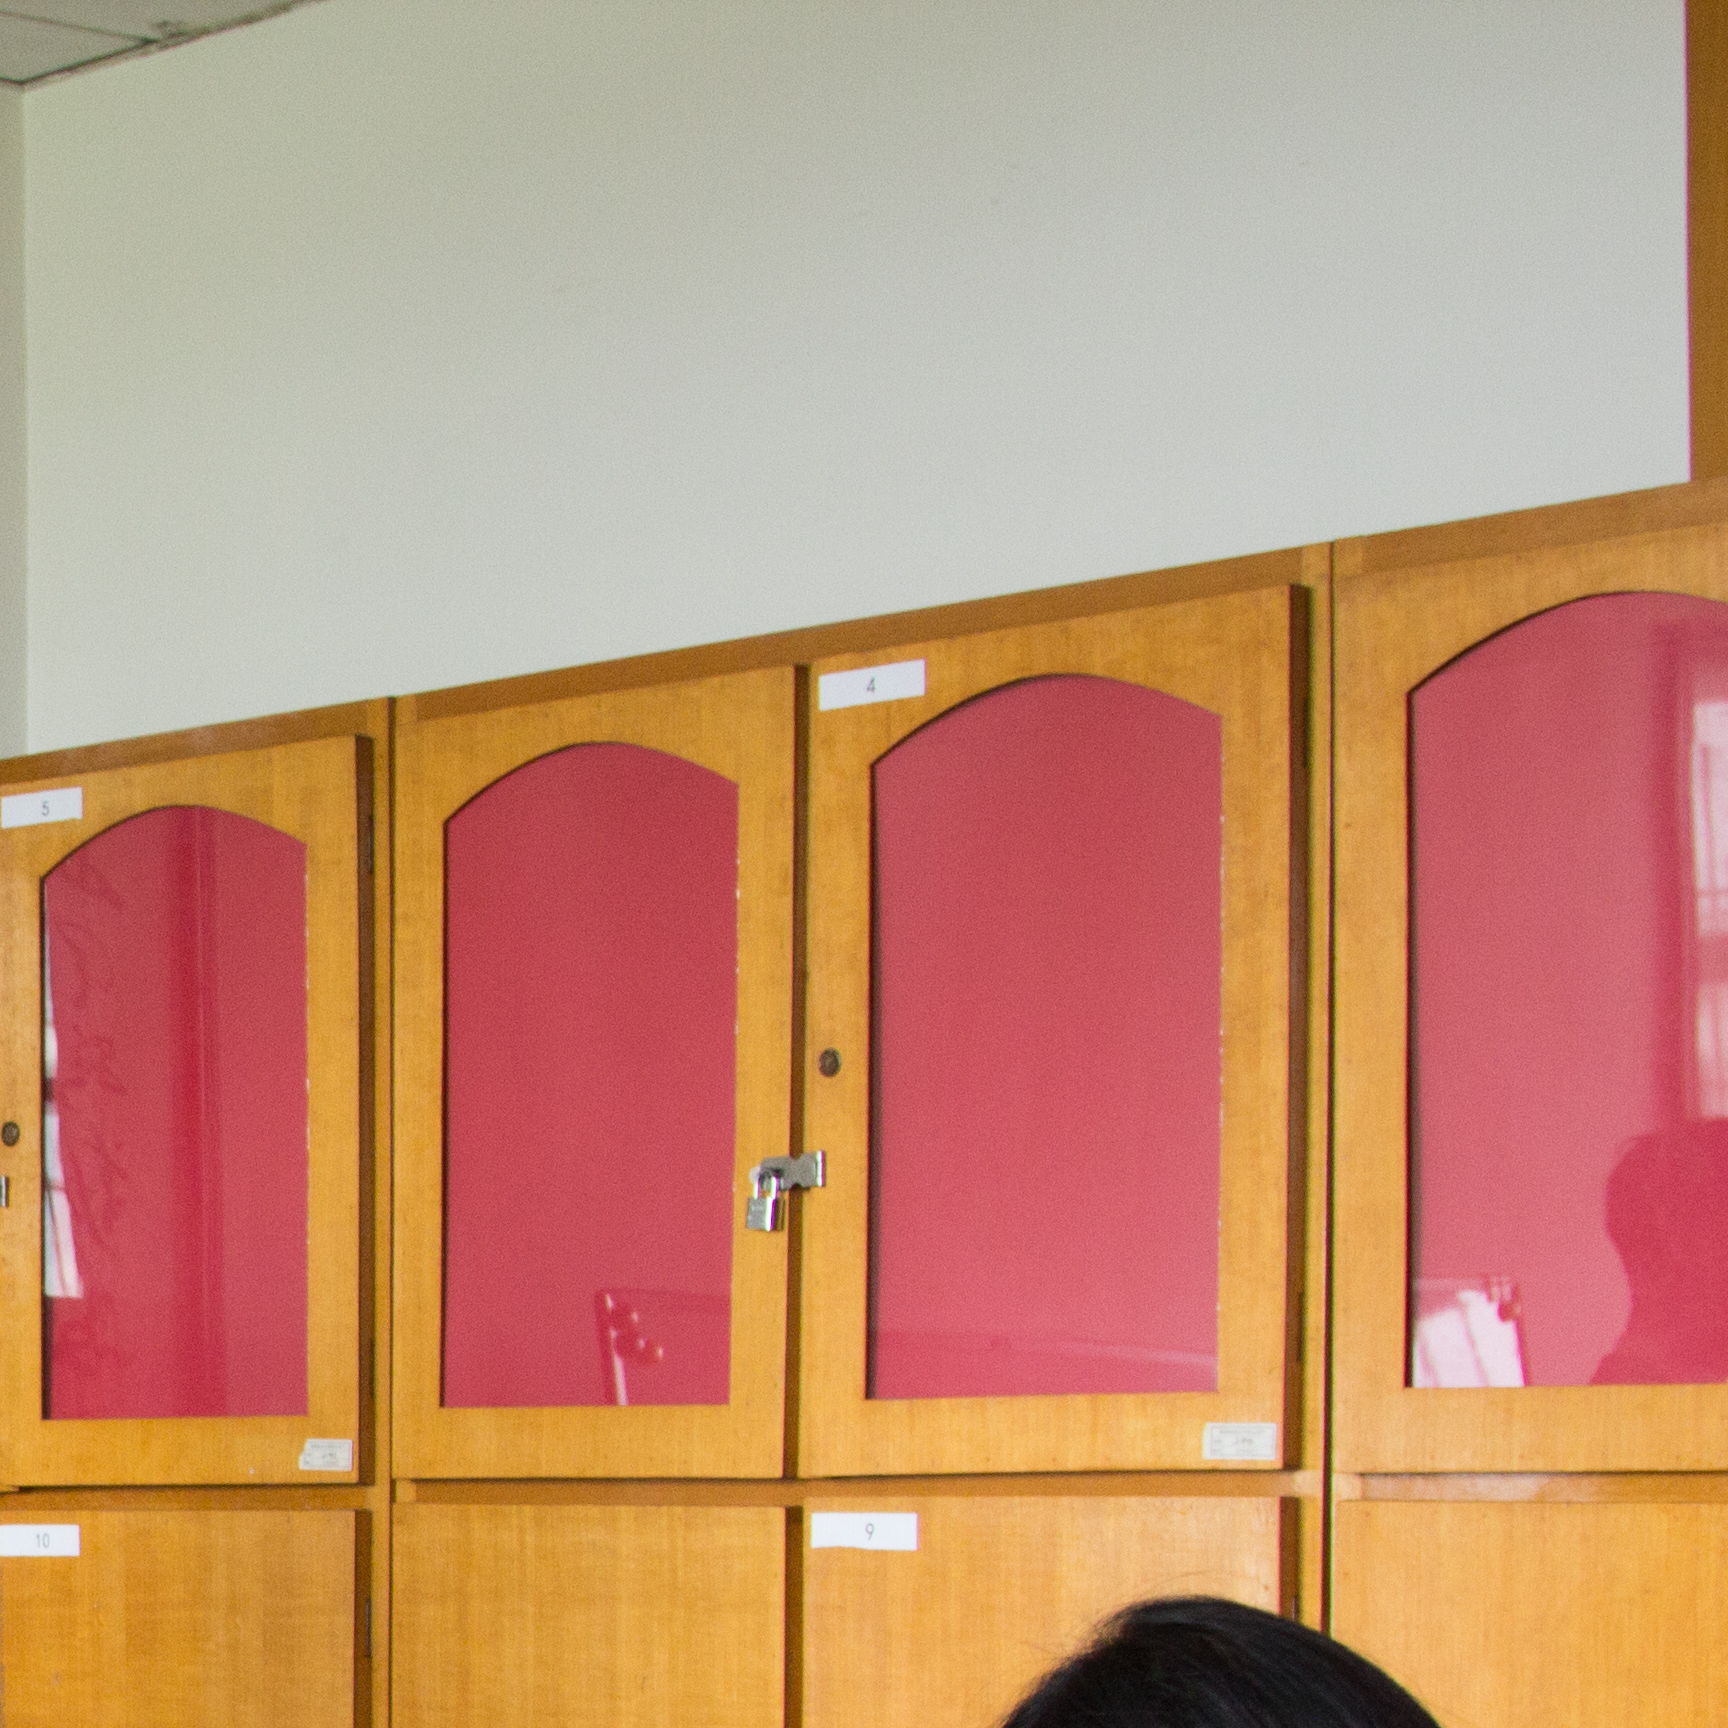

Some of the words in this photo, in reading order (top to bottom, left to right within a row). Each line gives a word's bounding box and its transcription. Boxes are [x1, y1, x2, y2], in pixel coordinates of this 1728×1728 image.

[866, 677, 876, 693] 4
[41, 800, 50, 816] 5
[865, 1523, 875, 1541] 9
[36, 1533, 50, 1548] 10
